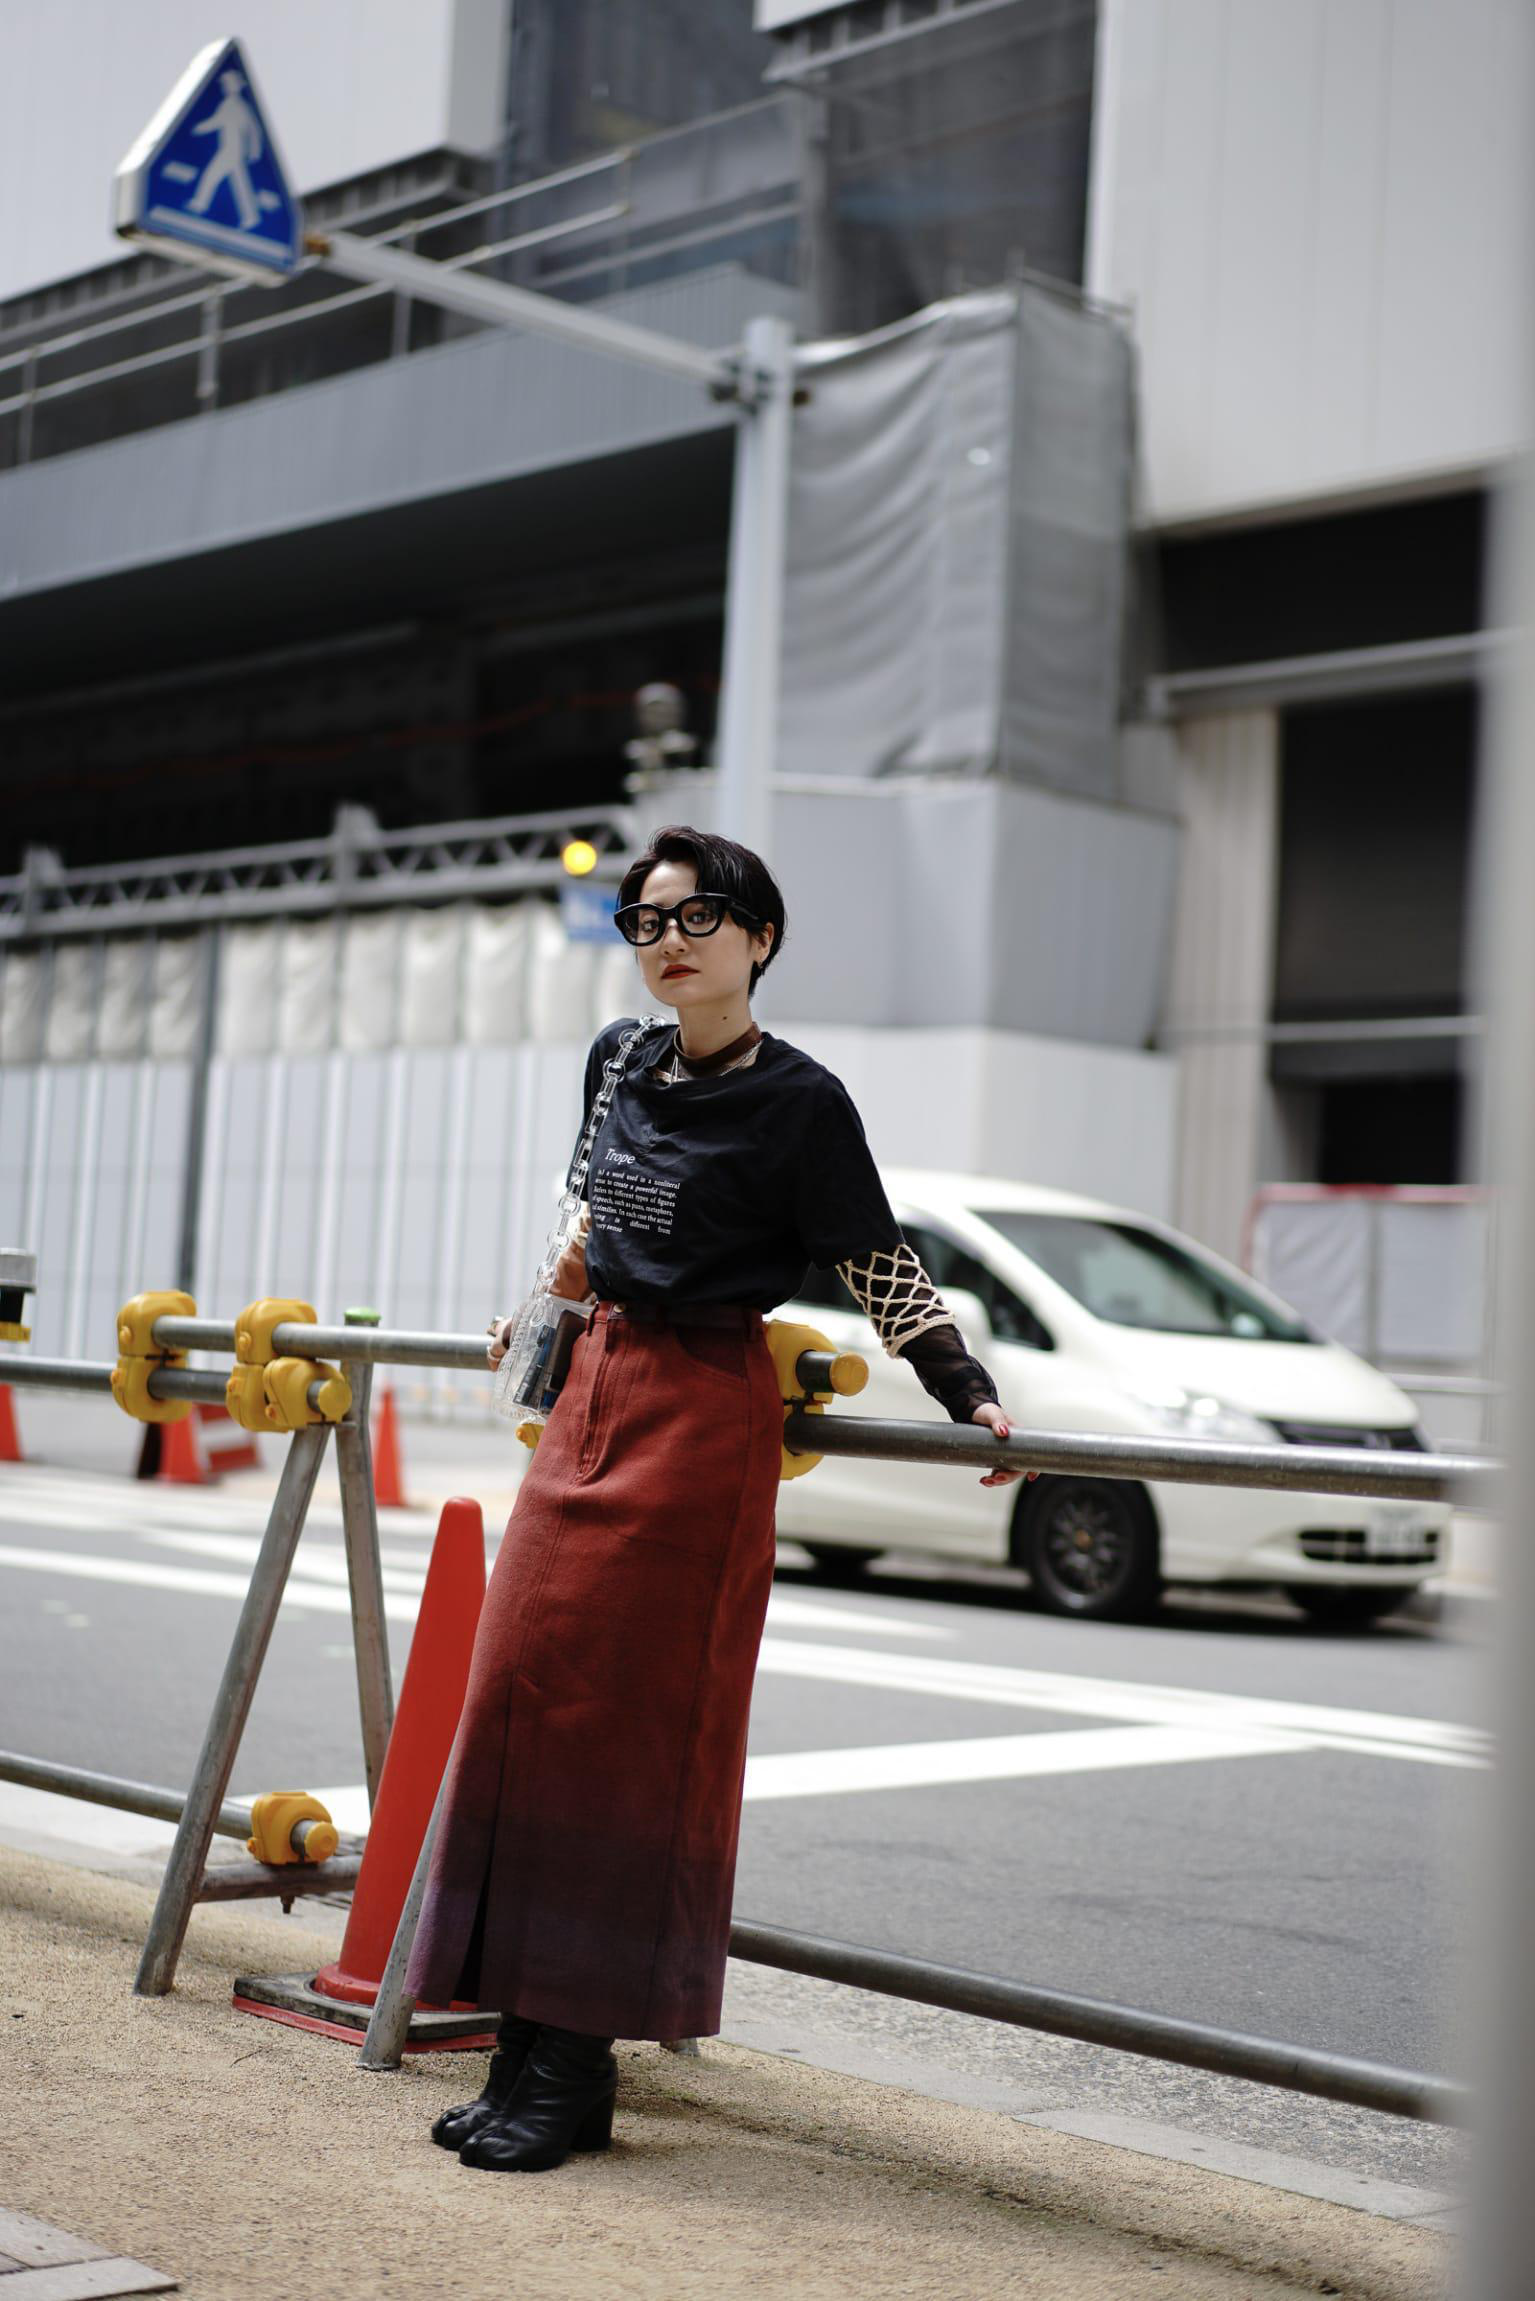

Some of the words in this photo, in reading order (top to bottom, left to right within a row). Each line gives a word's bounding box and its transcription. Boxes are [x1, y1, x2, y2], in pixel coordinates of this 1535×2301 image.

[605, 1148, 636, 1165] Trope
[635, 1186, 658, 1194] powerful
[614, 1189, 634, 1199] different
[658, 1198, 675, 1207] figures
[648, 1214, 656, 1222] the
[630, 1220, 650, 1230] different
[658, 1226, 671, 1235] from
